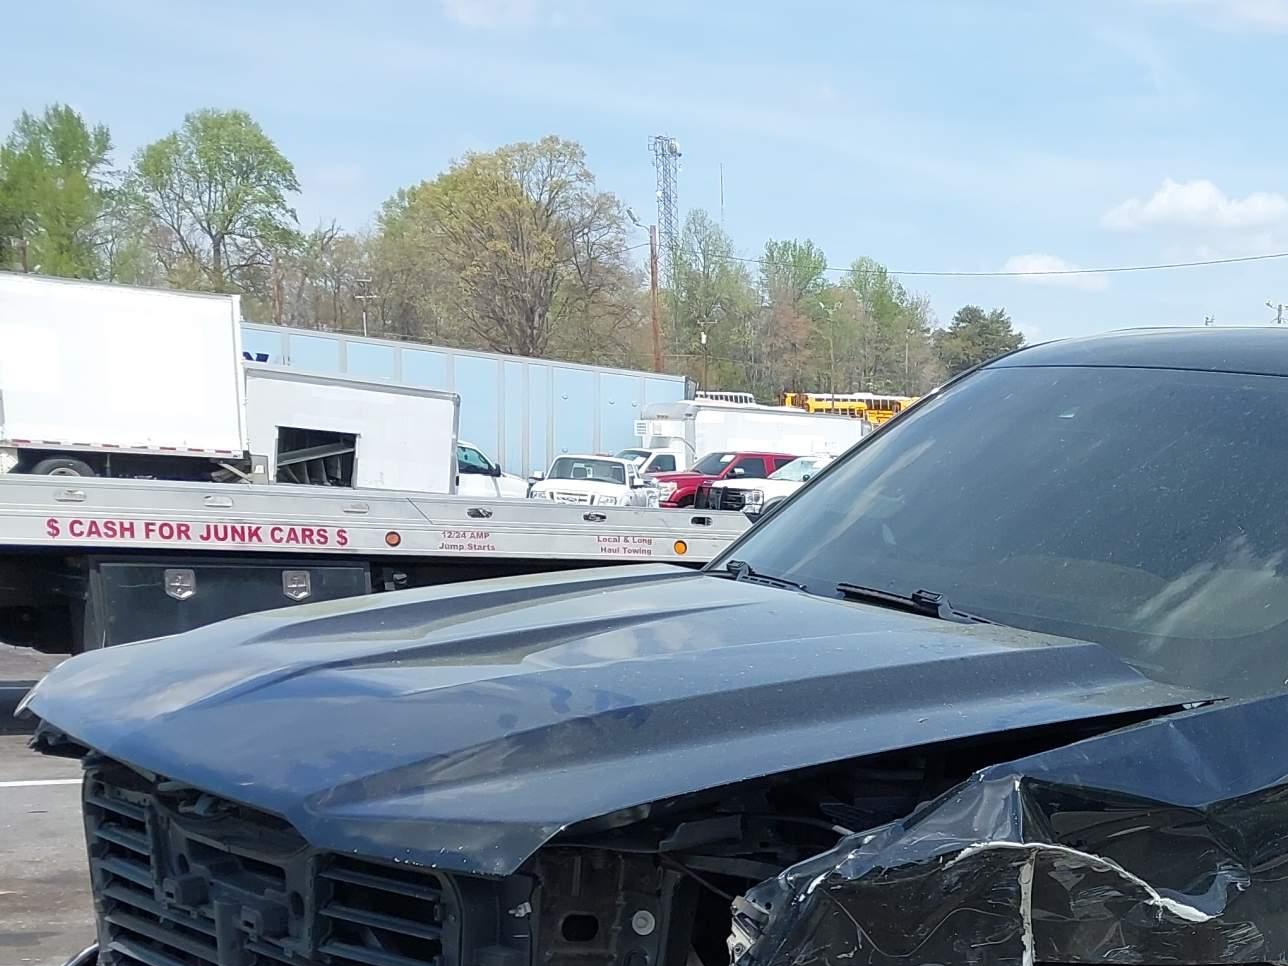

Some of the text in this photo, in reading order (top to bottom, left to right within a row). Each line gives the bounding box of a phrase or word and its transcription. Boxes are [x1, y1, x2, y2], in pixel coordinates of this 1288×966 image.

[46, 518, 348, 546] $ CASH FOR JUNK CARS $
[469, 531, 490, 540] AMP
[597, 535, 620, 543] Local
[632, 536, 653, 546] Long
[439, 542, 496, 551] Jump Starts
[622, 546, 652, 556] Towing
